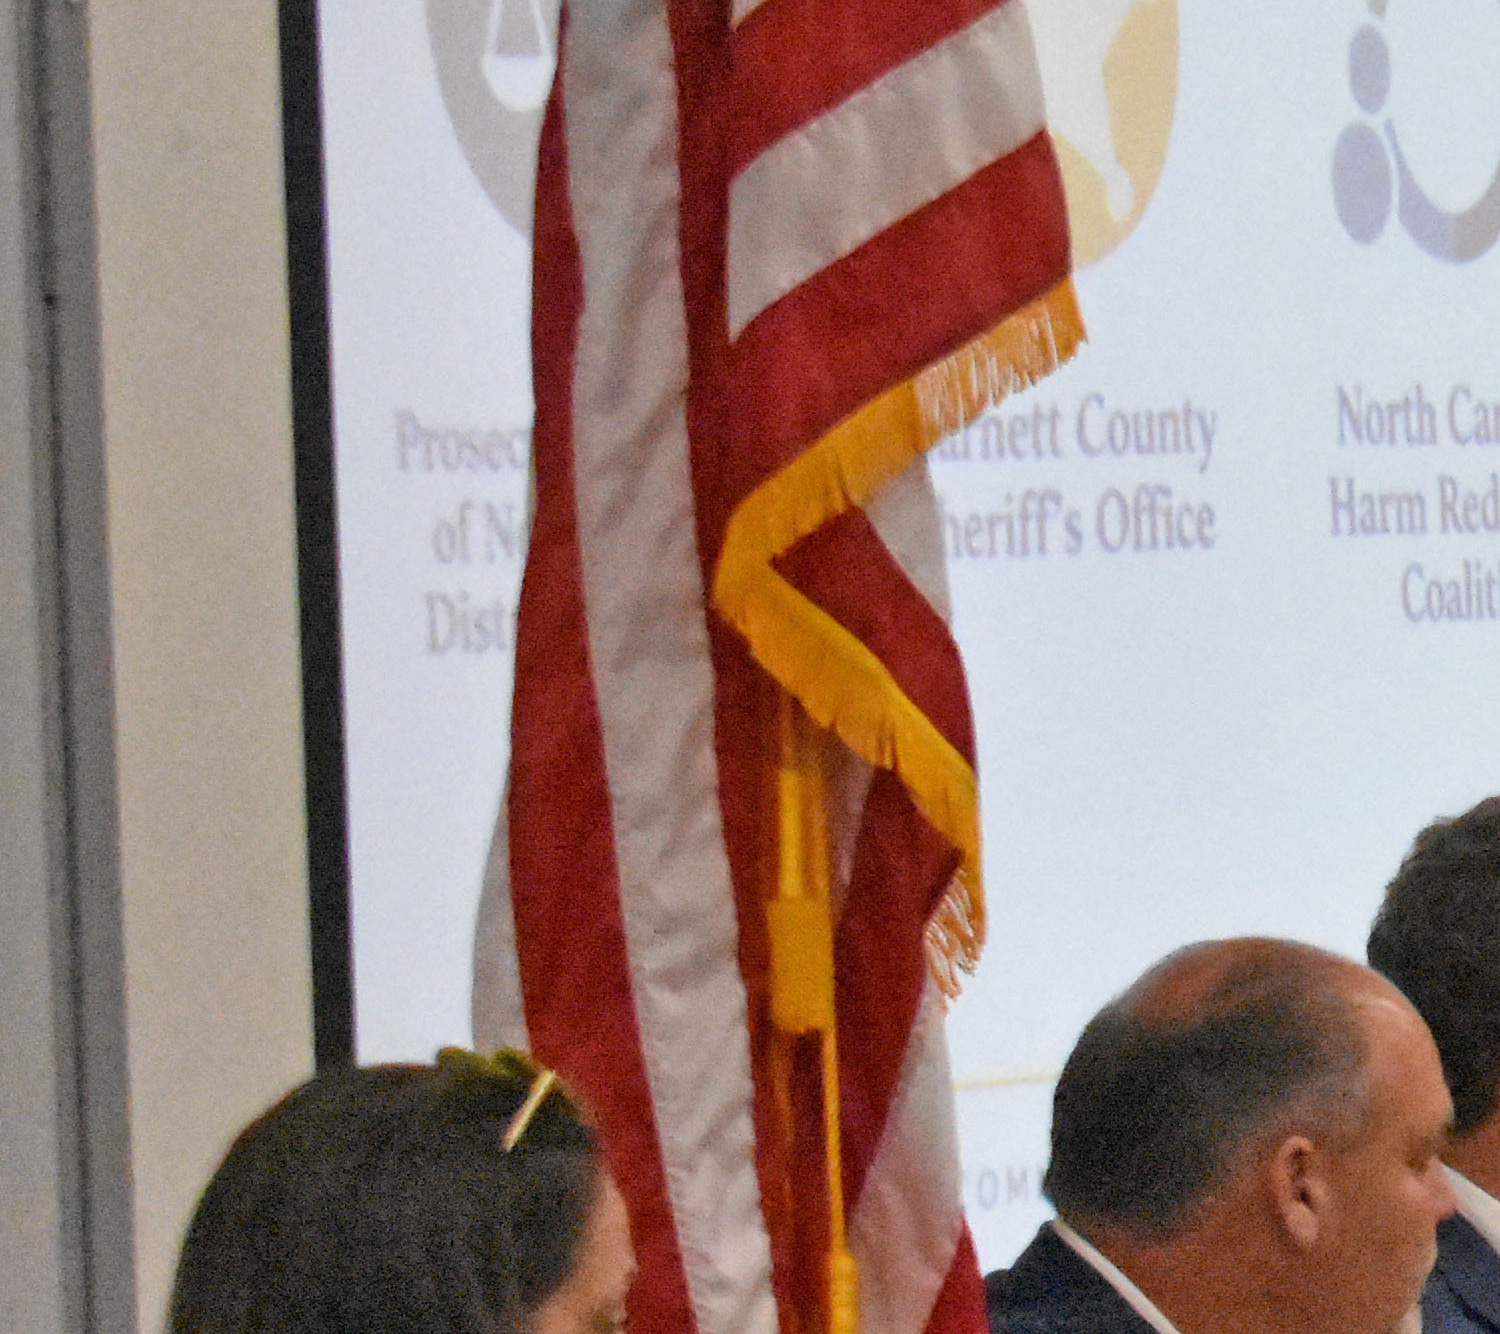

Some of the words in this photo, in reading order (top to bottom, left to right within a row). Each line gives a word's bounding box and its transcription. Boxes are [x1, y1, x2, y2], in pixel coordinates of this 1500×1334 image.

[938, 403, 1062, 463] rnett
[1077, 392, 1217, 473] County
[1336, 381, 1438, 448] North
[943, 487, 1084, 559] heriff's
[1095, 482, 1217, 553] Office
[1329, 475, 1428, 537] Harm
